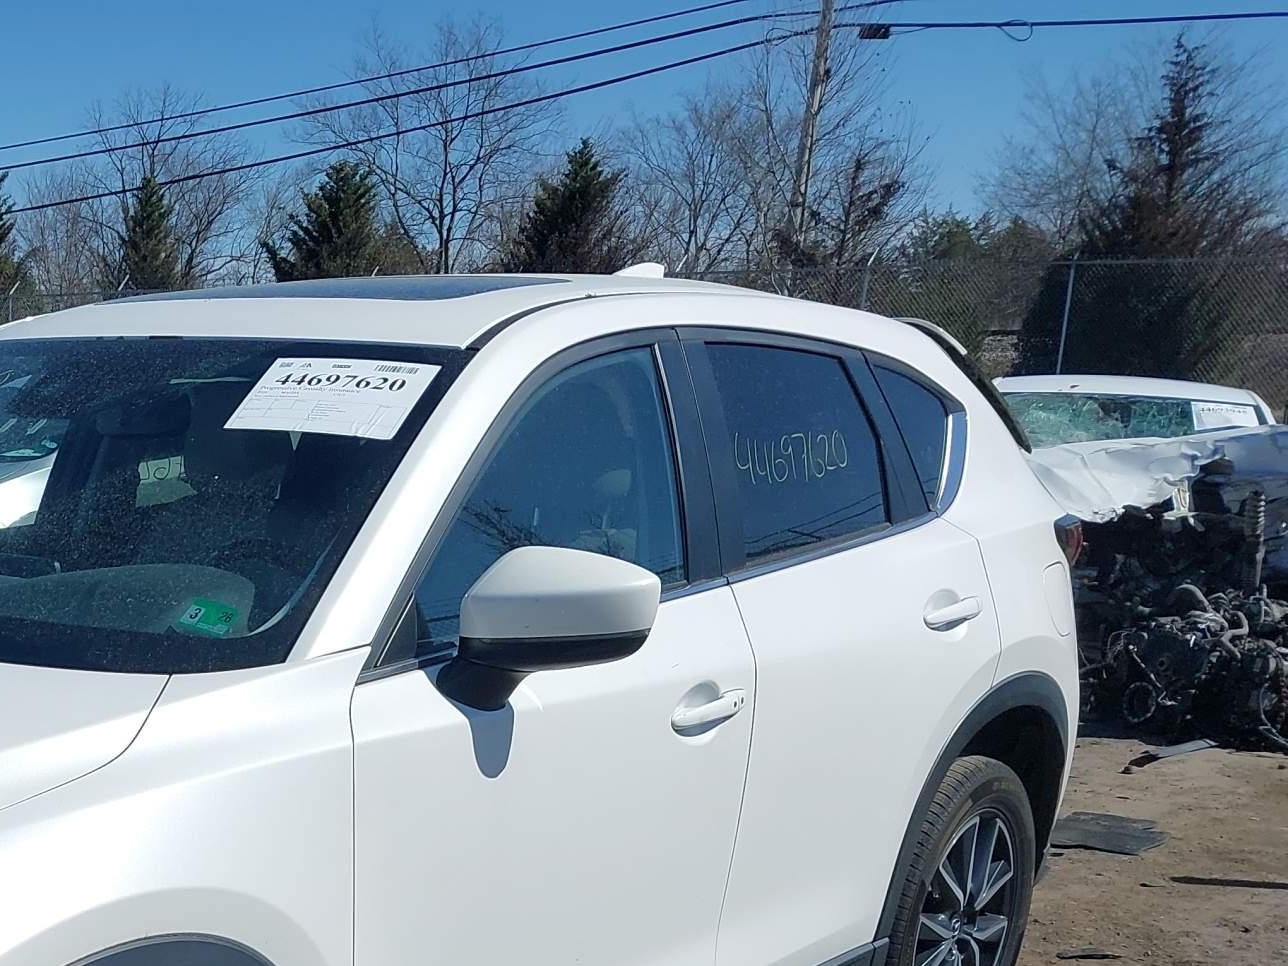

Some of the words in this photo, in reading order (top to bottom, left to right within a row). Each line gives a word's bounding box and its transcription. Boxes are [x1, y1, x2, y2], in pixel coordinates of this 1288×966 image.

[275, 372, 407, 393] 44697620
[734, 430, 848, 485] 44697620
[190, 608, 202, 620] 3
